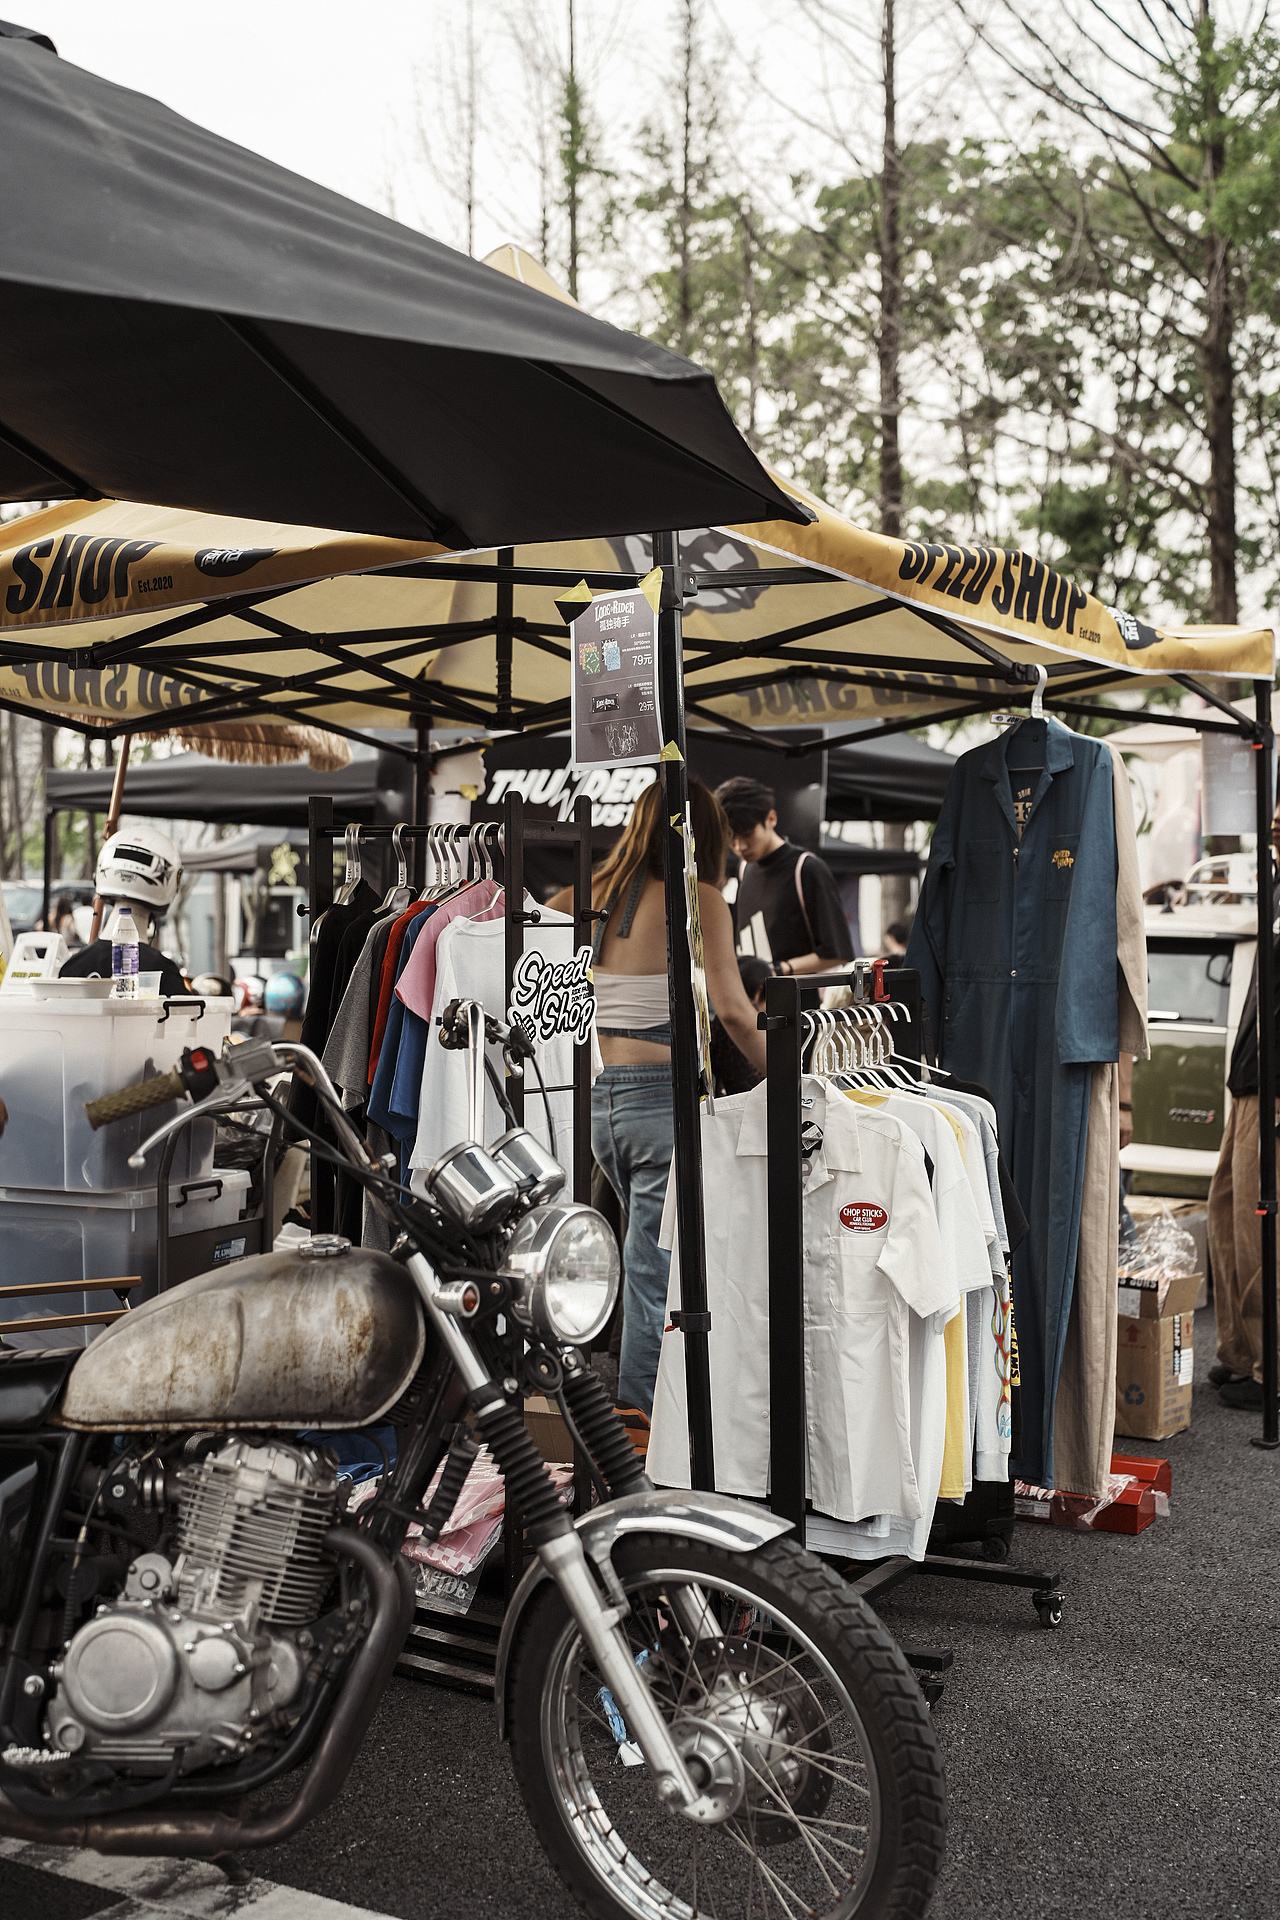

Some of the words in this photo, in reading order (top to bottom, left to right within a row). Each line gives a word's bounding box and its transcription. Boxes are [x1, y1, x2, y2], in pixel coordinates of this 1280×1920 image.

[6, 534, 166, 615] SHOP
[137, 575, 173, 594] Est.2020
[991, 550, 1087, 634] SHOP
[599, 615, 630, 632] 孤独骑手
[1079, 627, 1101, 644] Est.2020
[632, 653, 653, 666] 79元
[516, 950, 590, 1020] Speed
[541, 992, 595, 1040] Shop
[843, 1208, 860, 1216] CHOP
[862, 1209, 882, 1217] STICKS
